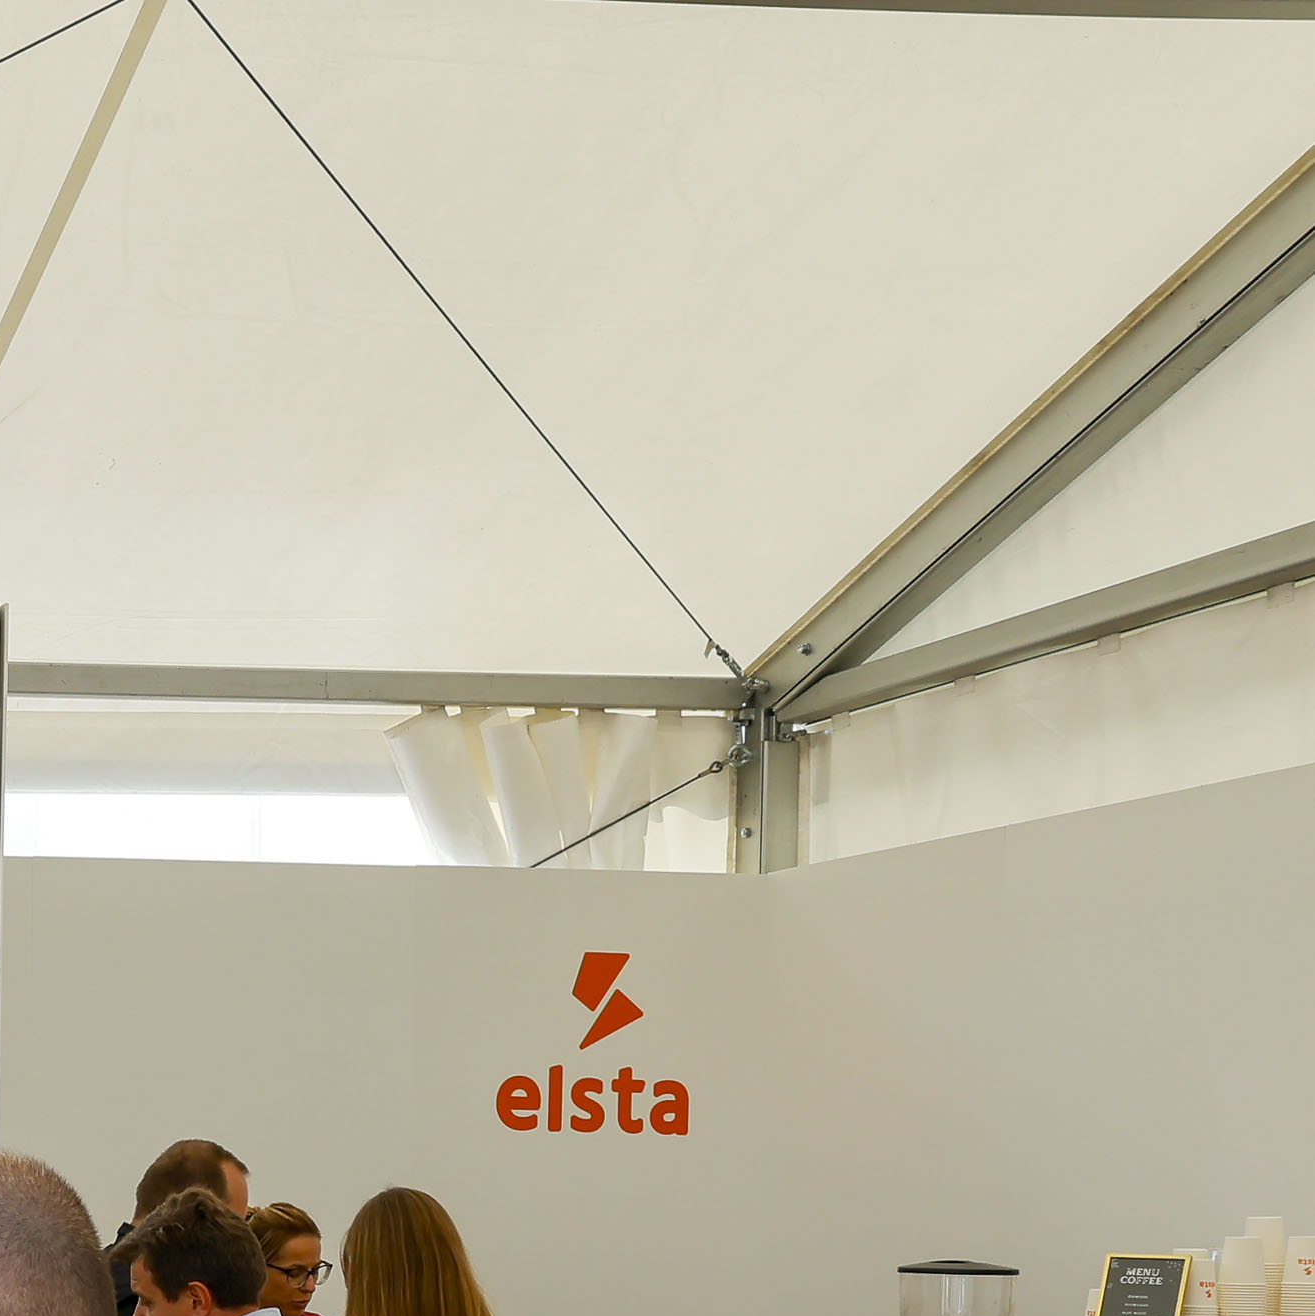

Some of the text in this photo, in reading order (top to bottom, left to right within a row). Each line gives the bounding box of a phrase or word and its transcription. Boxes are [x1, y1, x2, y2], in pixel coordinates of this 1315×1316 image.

[496, 1064, 689, 1136] elsta
[1126, 1268, 1160, 1277] MENU
[1120, 1276, 1164, 1285] COFFEE
